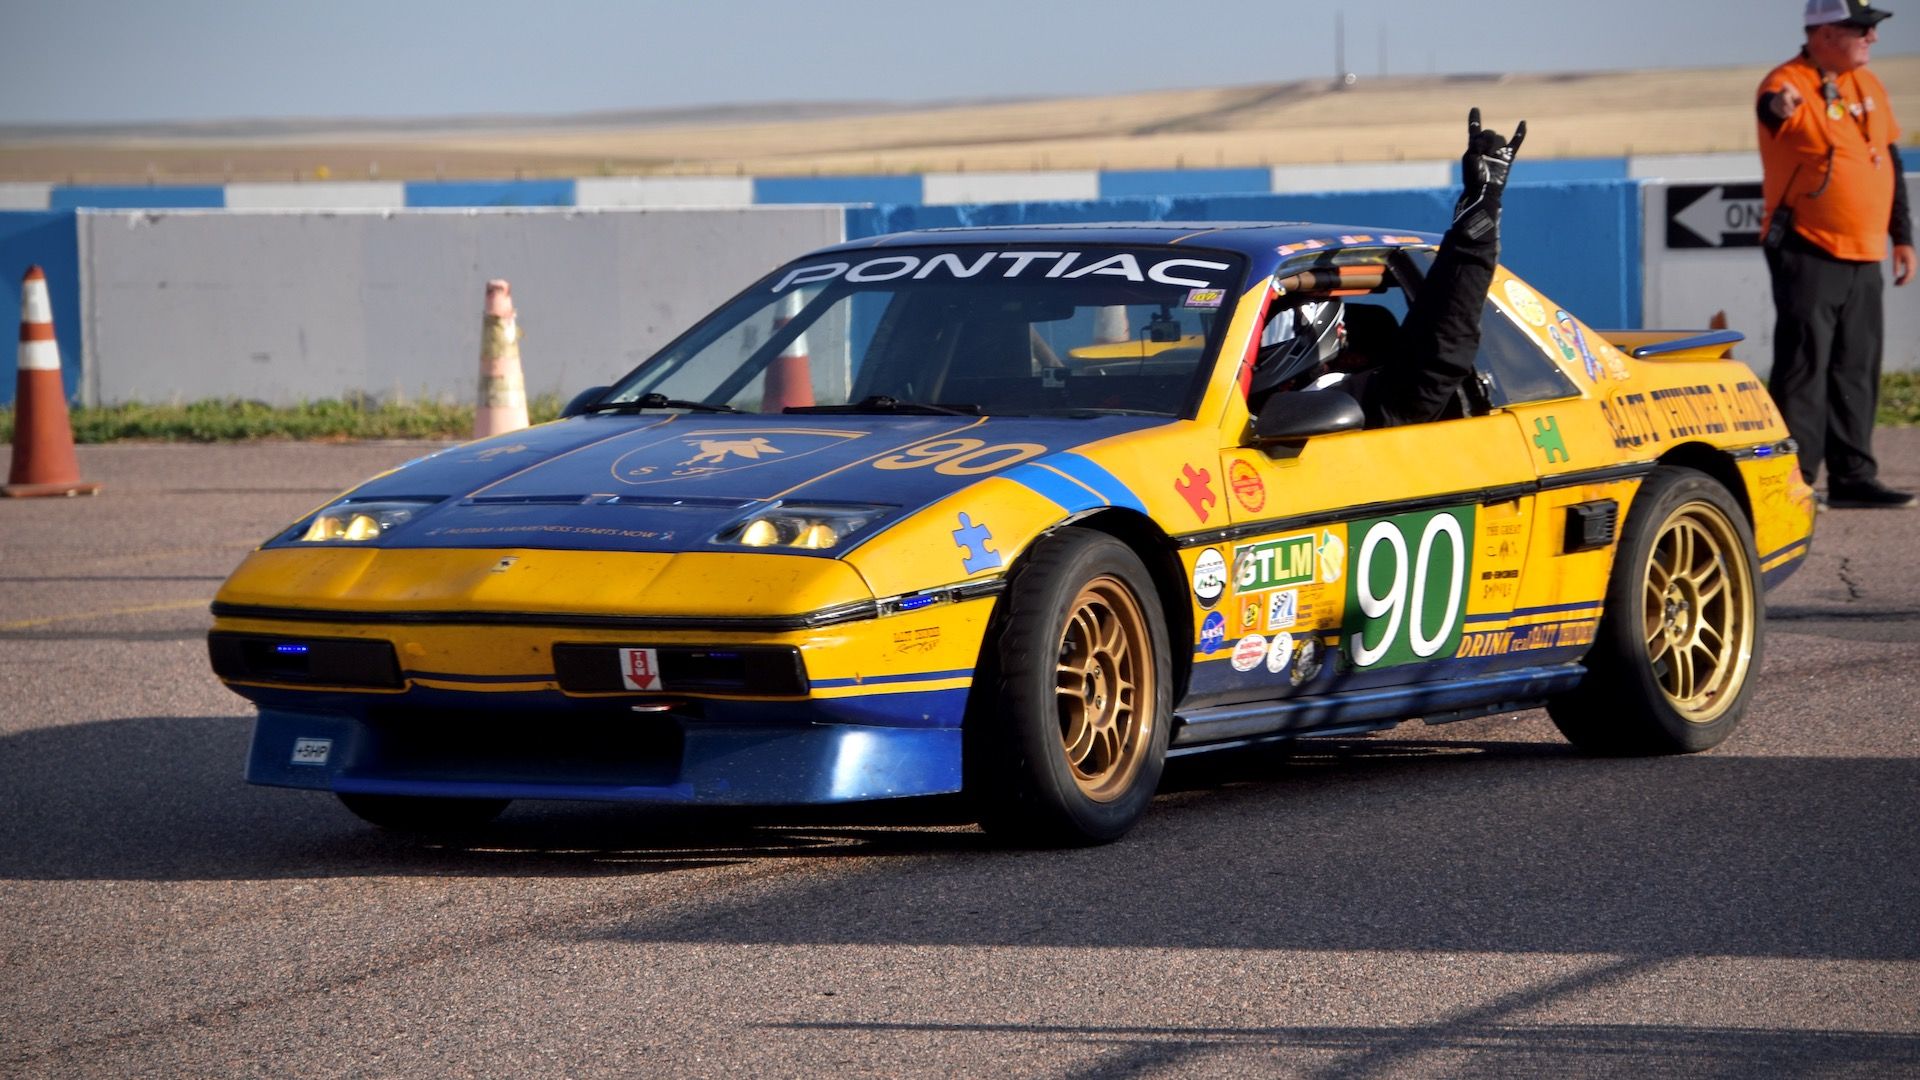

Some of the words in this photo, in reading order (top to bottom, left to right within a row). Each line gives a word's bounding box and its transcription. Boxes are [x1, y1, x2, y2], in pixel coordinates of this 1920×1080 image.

[772, 250, 1230, 292] PONTIAC
[872, 438, 1048, 476] 90
[573, 526, 619, 535] STARTS
[619, 529, 659, 539] NOW
[1351, 512, 1465, 667] 90
[1456, 633, 1514, 658] DRINK
[633, 651, 647, 676] TOW
[296, 744, 328, 758] +5HP
